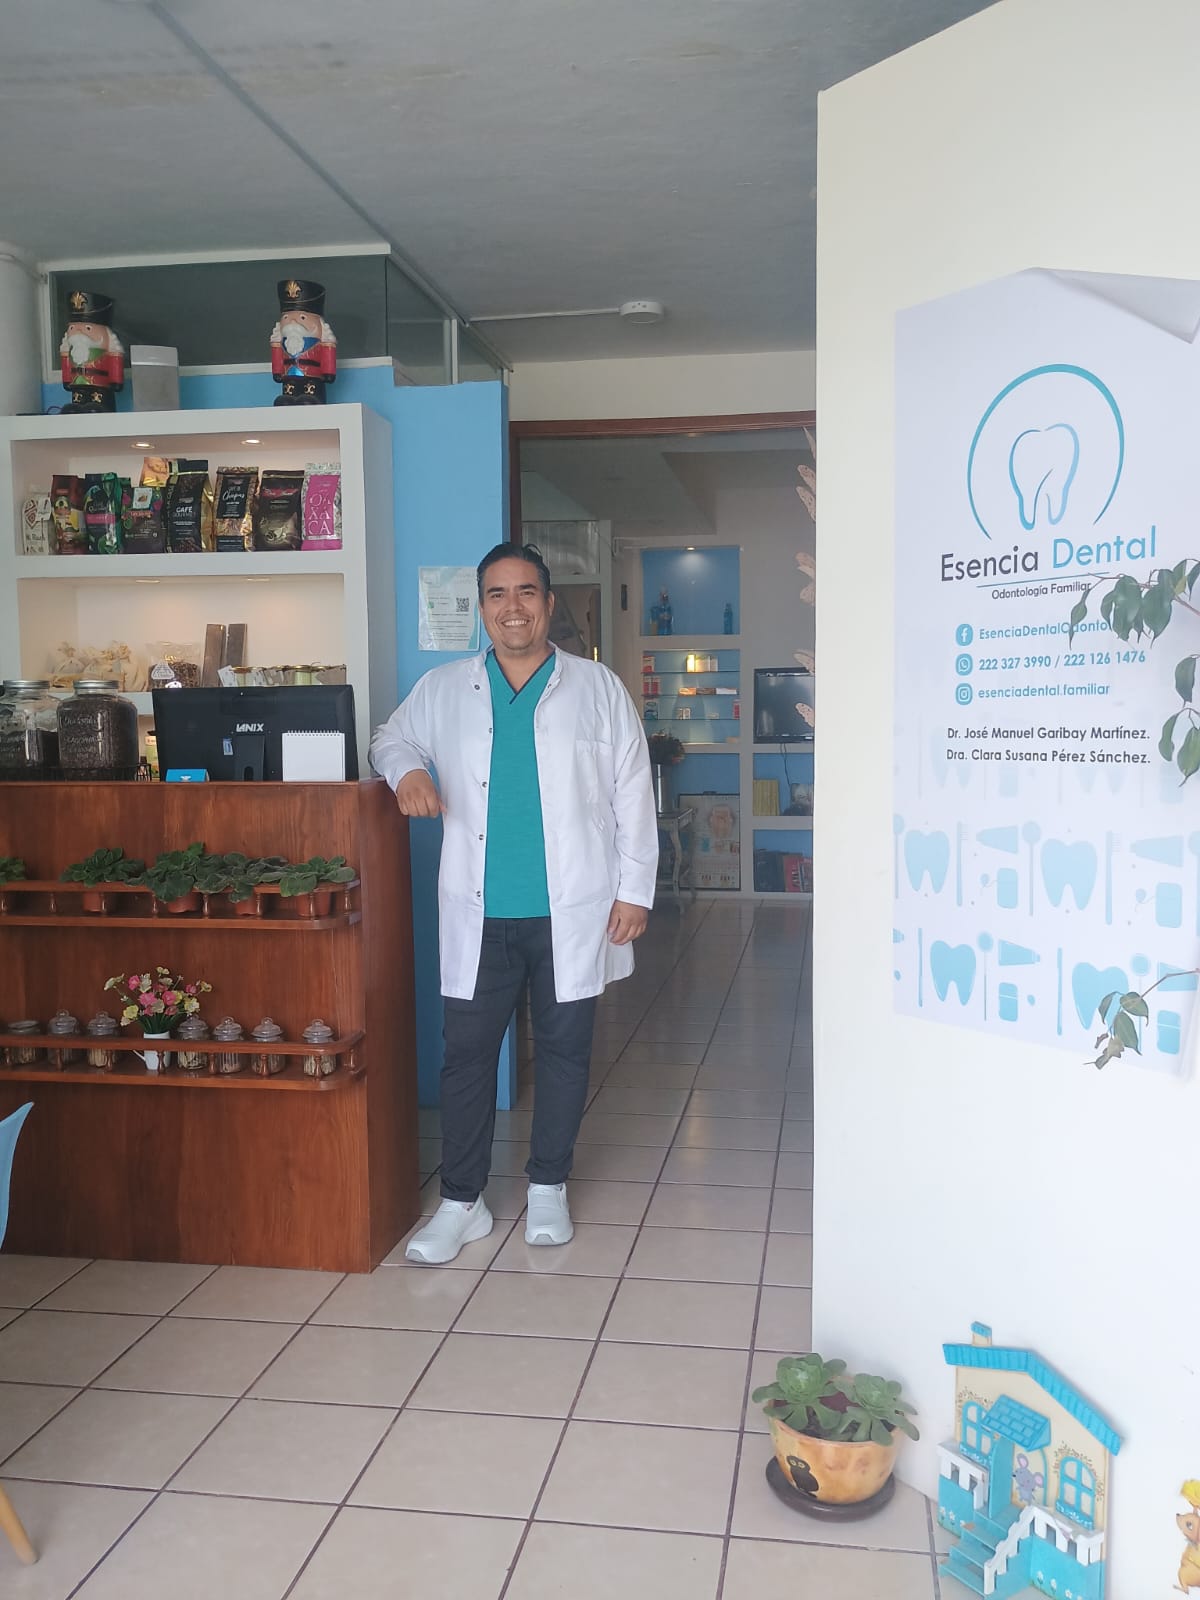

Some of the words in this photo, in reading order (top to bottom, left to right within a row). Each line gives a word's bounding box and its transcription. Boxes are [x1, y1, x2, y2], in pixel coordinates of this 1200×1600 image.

[941, 545, 1039, 582] Esencia
[1052, 525, 1156, 569] Dental
[991, 585, 1048, 600] Odontología
[1050, 581, 1092, 594] Familiar
[979, 658, 998, 671] 222
[1001, 657, 1021, 670] 327
[1023, 655, 1052, 669] 3990
[1054, 655, 1060, 669] /
[1064, 653, 1086, 667] 222
[1090, 652, 1111, 665] 126
[1117, 650, 1146, 664] 1476
[978, 683, 1111, 699] esenciadental.familiar
[236, 723, 264, 733] LANIX
[947, 727, 961, 739] Dr.
[964, 726, 989, 739] José
[991, 726, 1034, 739] Manuel
[1037, 727, 1086, 742] Garibay
[1090, 725, 1150, 740] Martínez.
[946, 749, 968, 761] Dra.
[971, 749, 1002, 761] Clara
[1005, 749, 1048, 762] Susana
[1051, 749, 1086, 763] Pérez
[1090, 749, 1151, 764] Sánchez.
